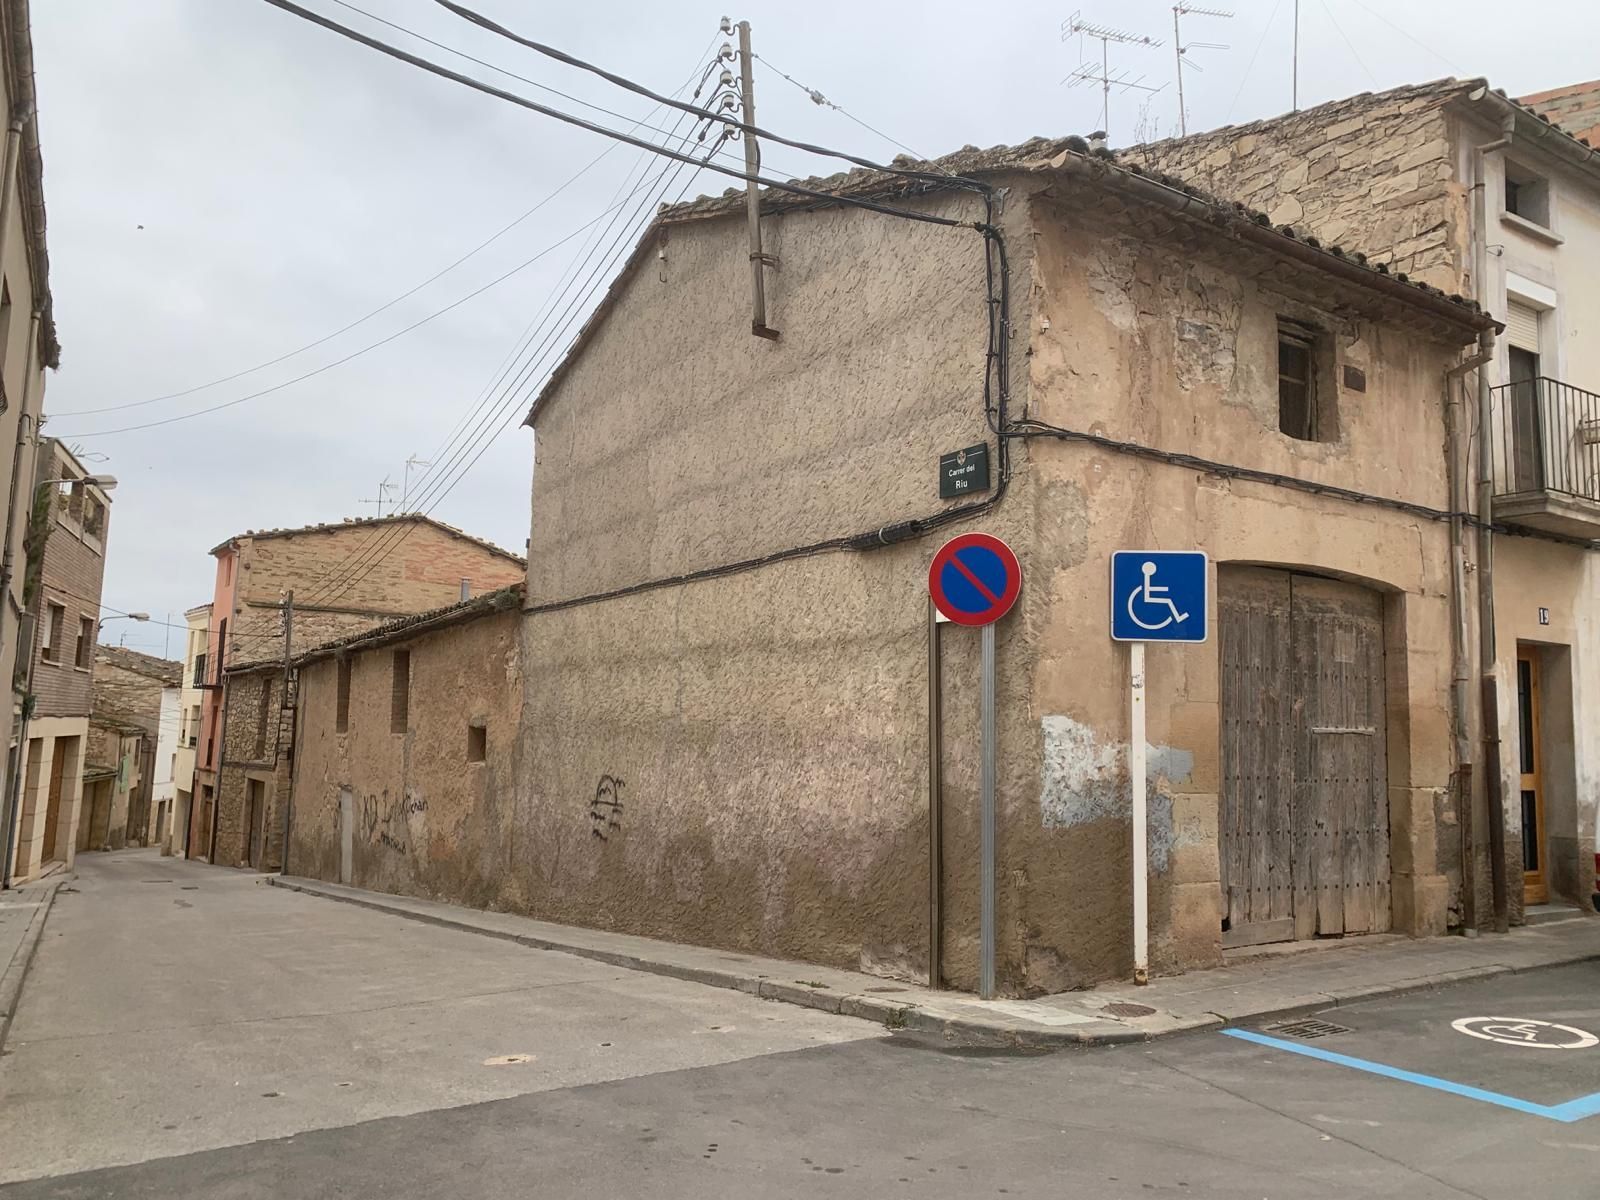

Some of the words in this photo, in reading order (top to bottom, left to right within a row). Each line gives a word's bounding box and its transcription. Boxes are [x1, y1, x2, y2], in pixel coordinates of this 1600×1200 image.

[949, 468, 965, 477] Carrer
[966, 464, 975, 472] del
[955, 480, 968, 489] Riu
[1540, 609, 1548, 623] 19
